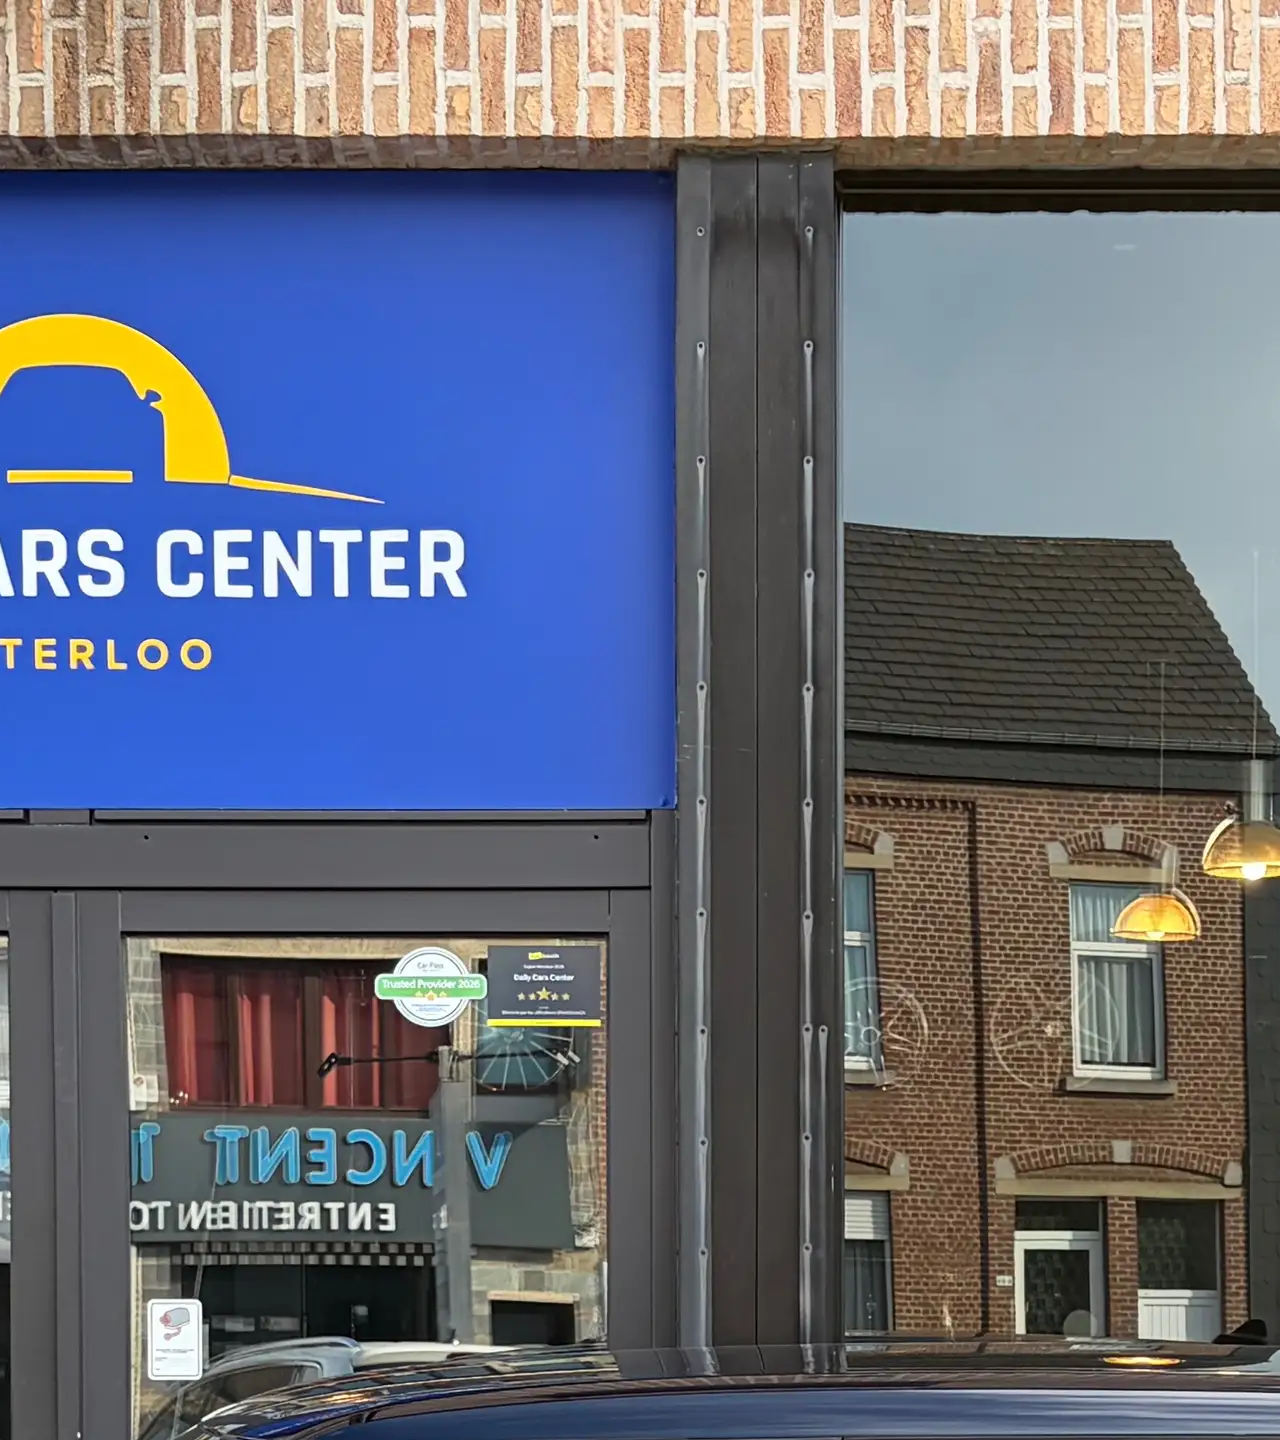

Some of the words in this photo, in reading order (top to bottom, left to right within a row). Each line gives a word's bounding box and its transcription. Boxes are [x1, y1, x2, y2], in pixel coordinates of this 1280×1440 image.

[156, 529, 468, 599] CENTER
[382, 978, 416, 989] Trusted
[417, 978, 457, 989] Provider
